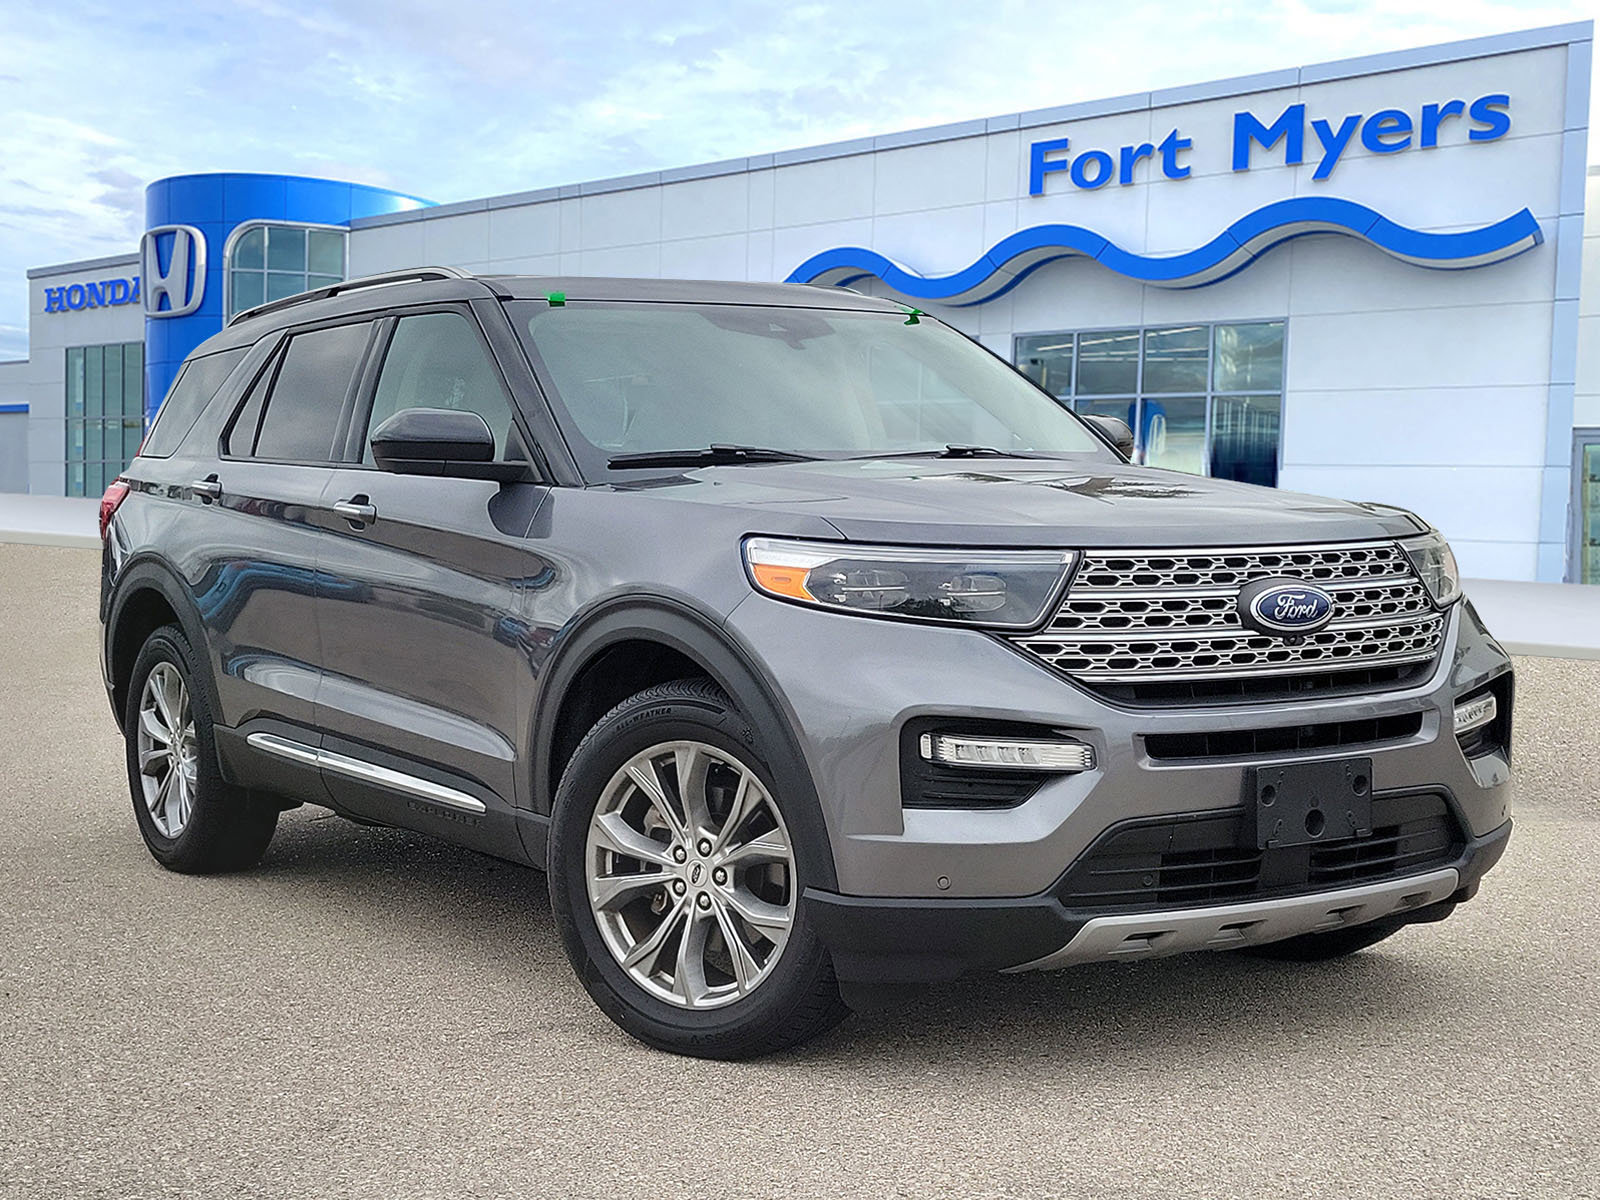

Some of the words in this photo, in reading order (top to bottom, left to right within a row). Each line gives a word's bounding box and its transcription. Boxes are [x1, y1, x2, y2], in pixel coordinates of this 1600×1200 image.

[1028, 128, 1192, 197] Fort
[1231, 93, 1511, 181] Myers
[1273, 593, 1319, 620] Ford
[616, 707, 673, 732] ALL-WEATHER
